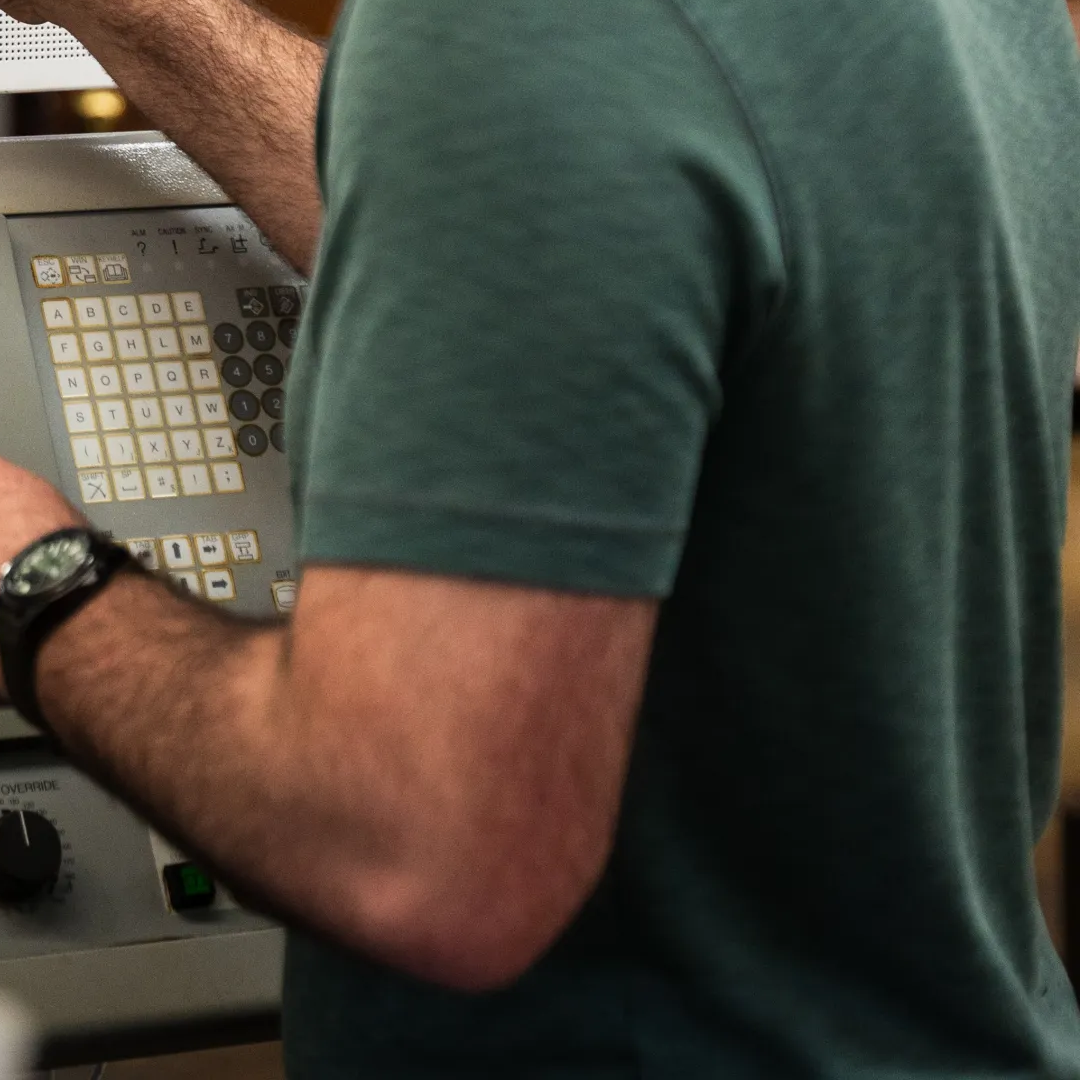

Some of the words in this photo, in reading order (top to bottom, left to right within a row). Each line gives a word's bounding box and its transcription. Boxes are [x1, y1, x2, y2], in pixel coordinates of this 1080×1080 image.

[119, 305, 128, 315] C
[152, 304, 161, 313] D
[185, 301, 193, 311] E
[55, 310, 62, 319] A
[87, 308, 95, 317] B
[191, 336, 202, 345] M
[225, 333, 231, 343] 7
[257, 331, 265, 341] 8
[94, 342, 103, 351] G
[127, 340, 136, 349] H
[160, 338, 167, 347] L
[61, 343, 66, 352] F
[200, 369, 209, 379] R
[234, 368, 240, 376] 4
[265, 365, 273, 375] 5
[134, 374, 142, 382] P
[167, 371, 176, 381] Q
[68, 378, 77, 387] N
[101, 376, 110, 386] O
[175, 406, 182, 415] V
[206, 404, 217, 413] W
[243, 402, 247, 410] 1
[76, 412, 84, 422] S
[109, 410, 115, 419] T
[142, 408, 150, 418] U
[216, 437, 224, 448] Z
[249, 435, 256, 445] 0
[150, 442, 158, 452] X
[182, 440, 190, 450] Y
[0, 780, 60, 795] OVERRIDE
